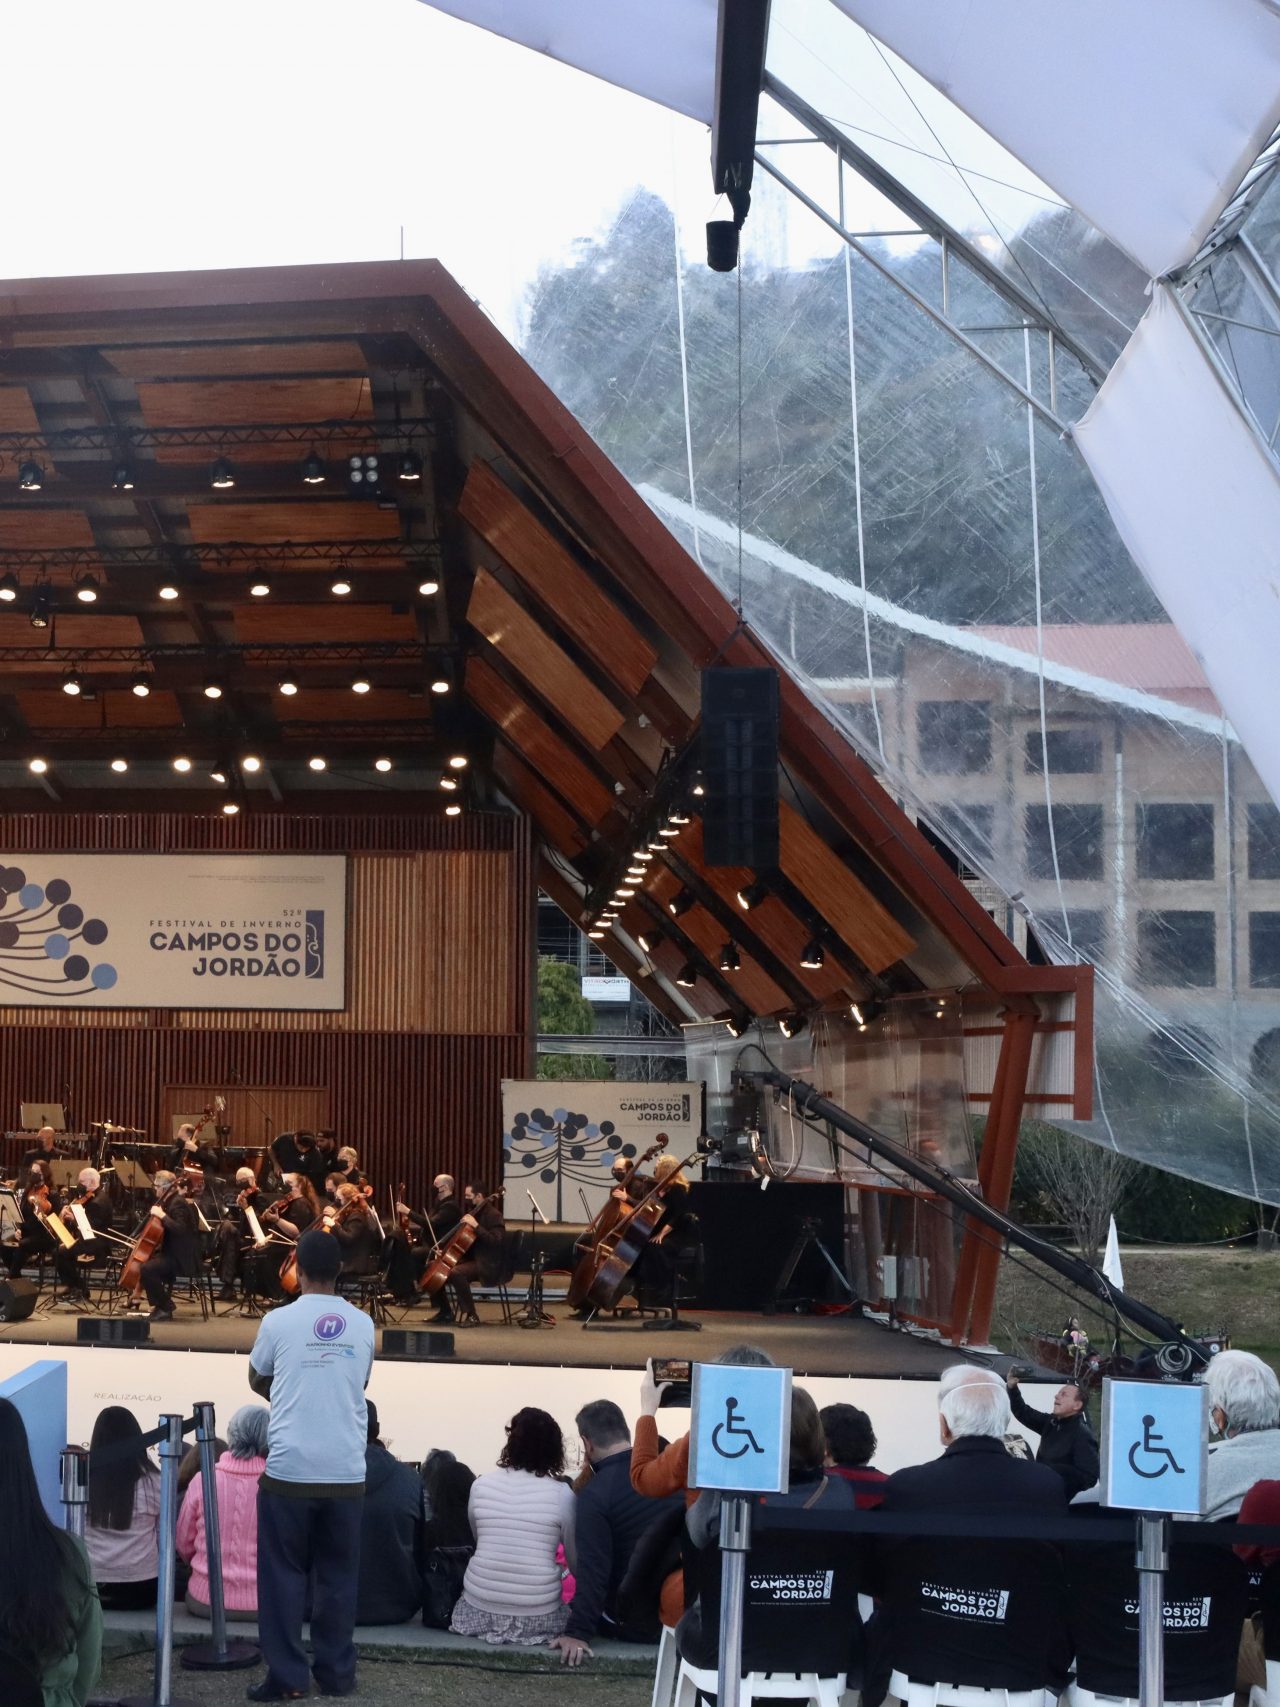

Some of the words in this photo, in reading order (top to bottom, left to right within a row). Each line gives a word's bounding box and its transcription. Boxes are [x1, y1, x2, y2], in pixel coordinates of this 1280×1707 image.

[150, 932, 258, 951] CAMPOS
[265, 933, 302, 952] DO
[193, 953, 301, 977] JORDÃO
[620, 1103, 664, 1111] CAMPOS
[666, 1103, 681, 1111] DO
[637, 1112, 681, 1121] JORDÃO
[323, 1320, 337, 1334] M
[94, 1392, 162, 1402] REALIZAÇÃO
[750, 1580, 805, 1589] CAMPOS
[807, 1580, 823, 1588] DO
[922, 1582, 952, 1591] FESTIVAL
[772, 1588, 822, 1599] JORDÃO
[922, 1587, 976, 1604] CAMPOS
[978, 1598, 996, 1607] DO
[942, 1602, 995, 1617] JORDÃO
[1184, 1608, 1200, 1616] DO
